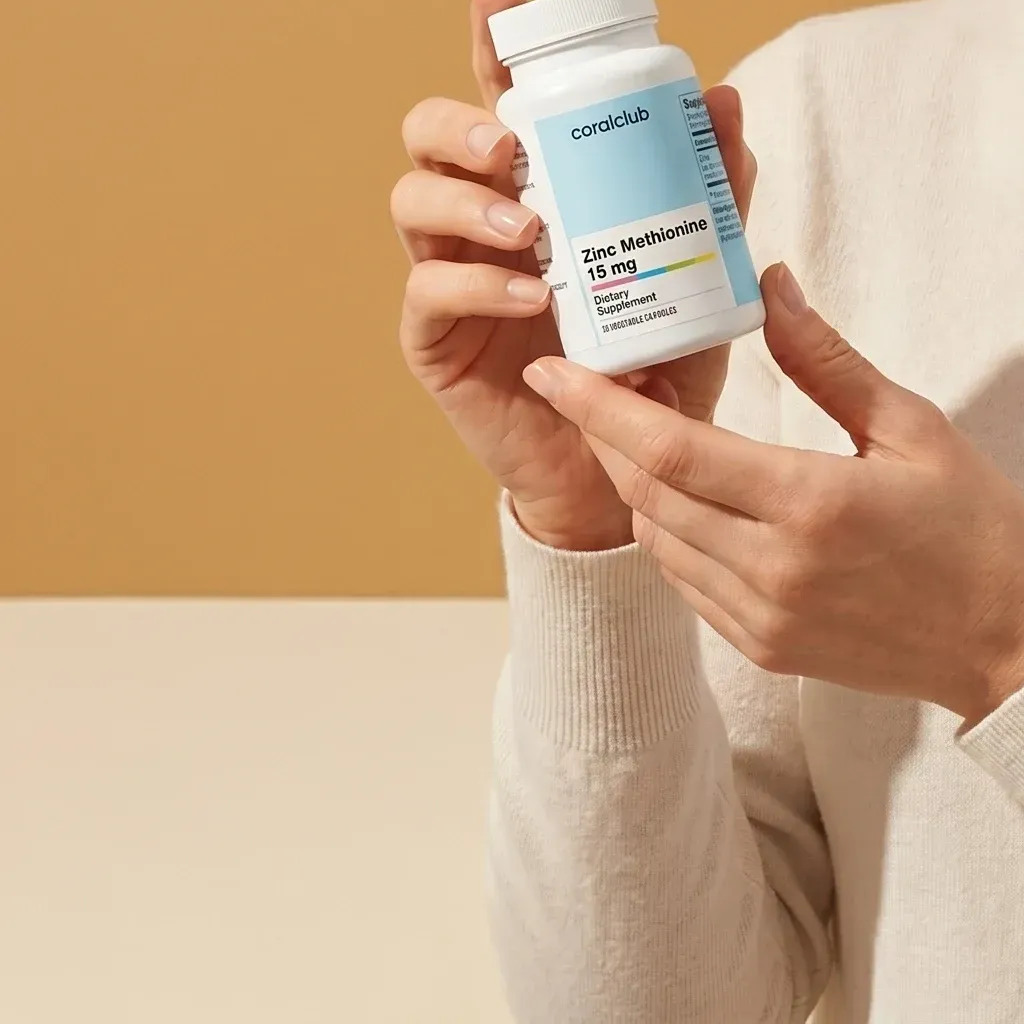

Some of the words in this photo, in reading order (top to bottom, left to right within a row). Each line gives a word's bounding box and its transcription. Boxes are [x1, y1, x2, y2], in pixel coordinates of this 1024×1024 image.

[571, 106, 650, 140] coralclub
[581, 245, 617, 264] Zinc
[620, 219, 708, 253] Methionine
[587, 264, 607, 281] 15
[611, 259, 637, 274] mg
[594, 290, 629, 305] Dietary
[597, 292, 657, 316] Supplement
